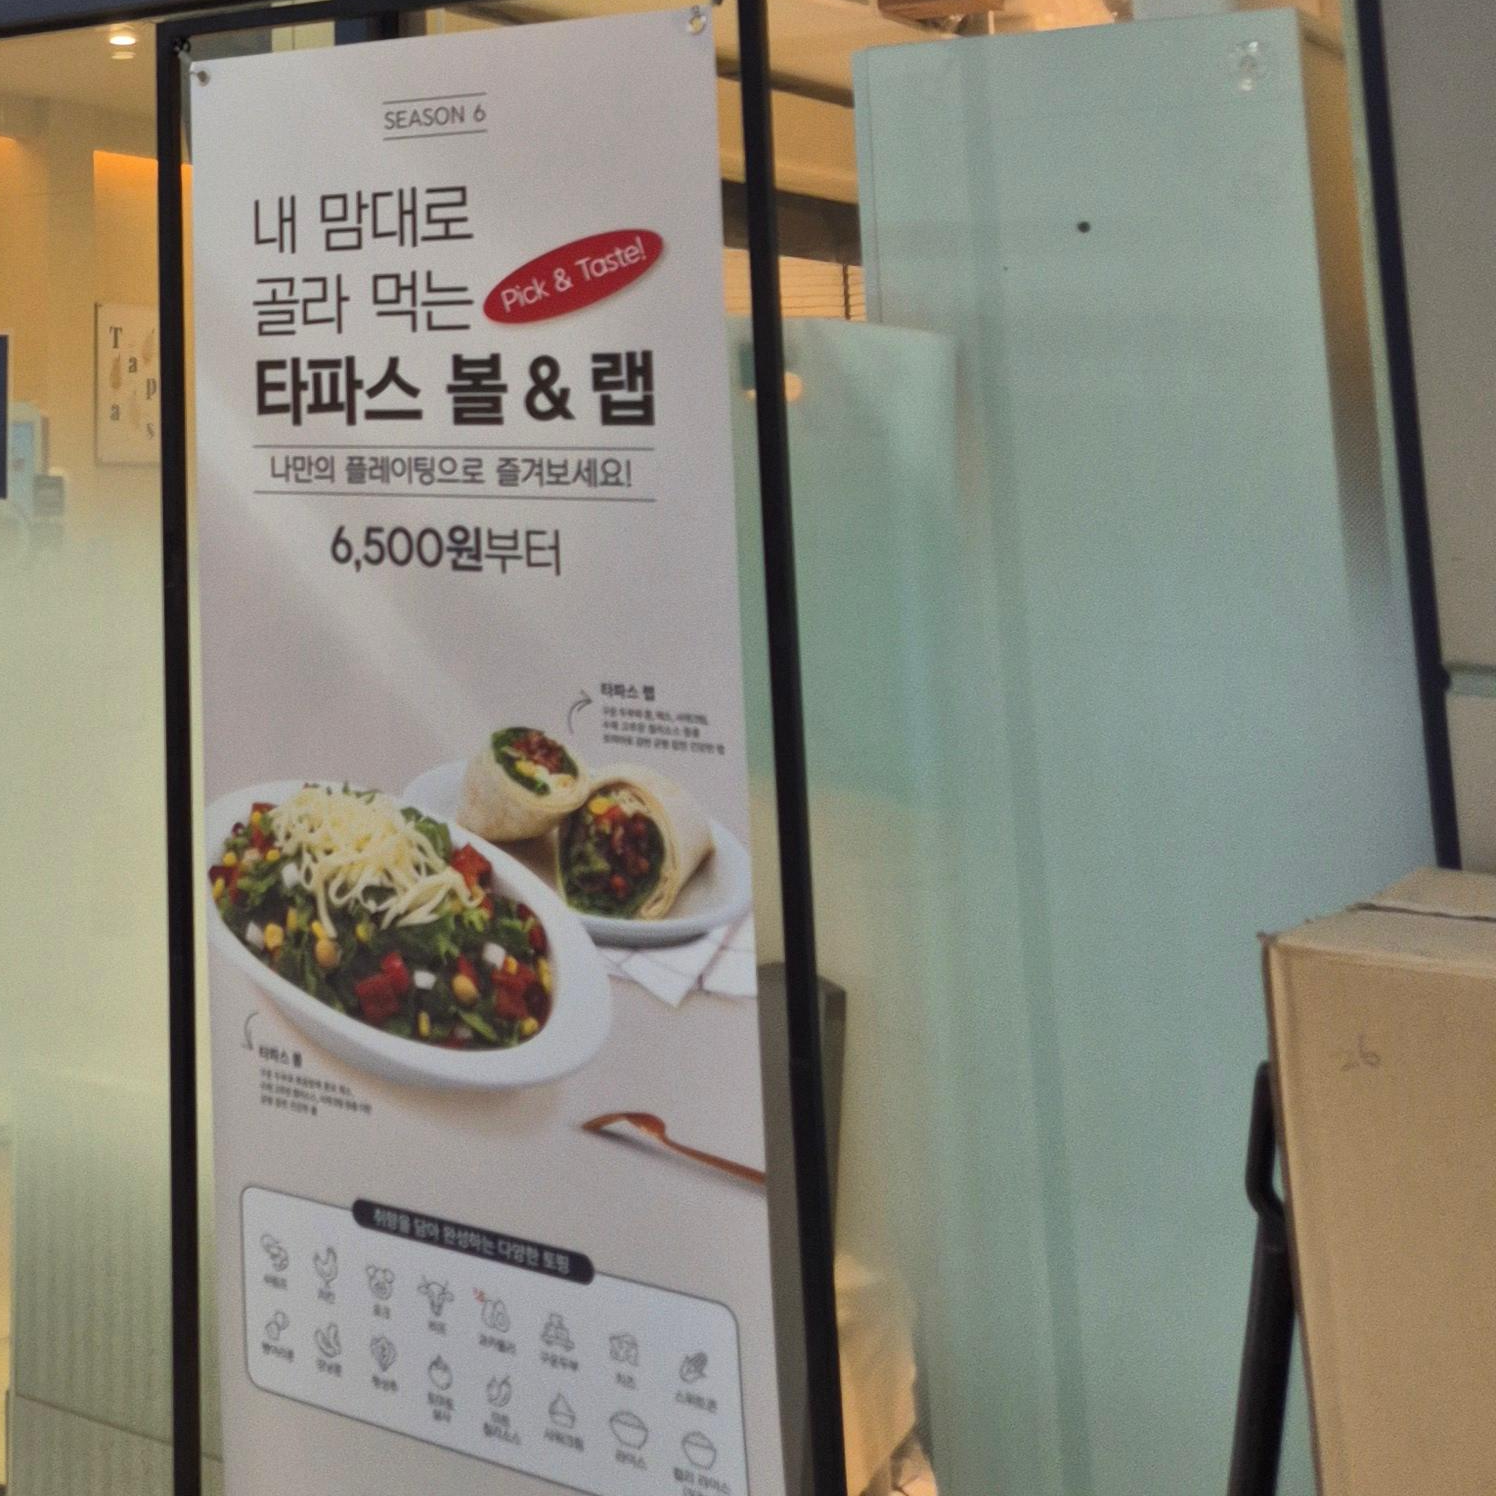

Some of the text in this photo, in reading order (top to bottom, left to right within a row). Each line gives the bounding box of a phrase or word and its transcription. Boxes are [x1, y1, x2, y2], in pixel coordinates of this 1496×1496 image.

[383, 103, 487, 131] SEASON 6
[253, 185, 474, 254] 내 맘대로
[252, 269, 474, 336] 골라 먹는
[500, 235, 647, 313] Pick & Taste!
[255, 349, 656, 426] 타파스 볼 & 랩
[269, 454, 633, 488] 나만의 플레이팅으로 즐겨보세요!
[330, 524, 562, 577] 6,500원부터
